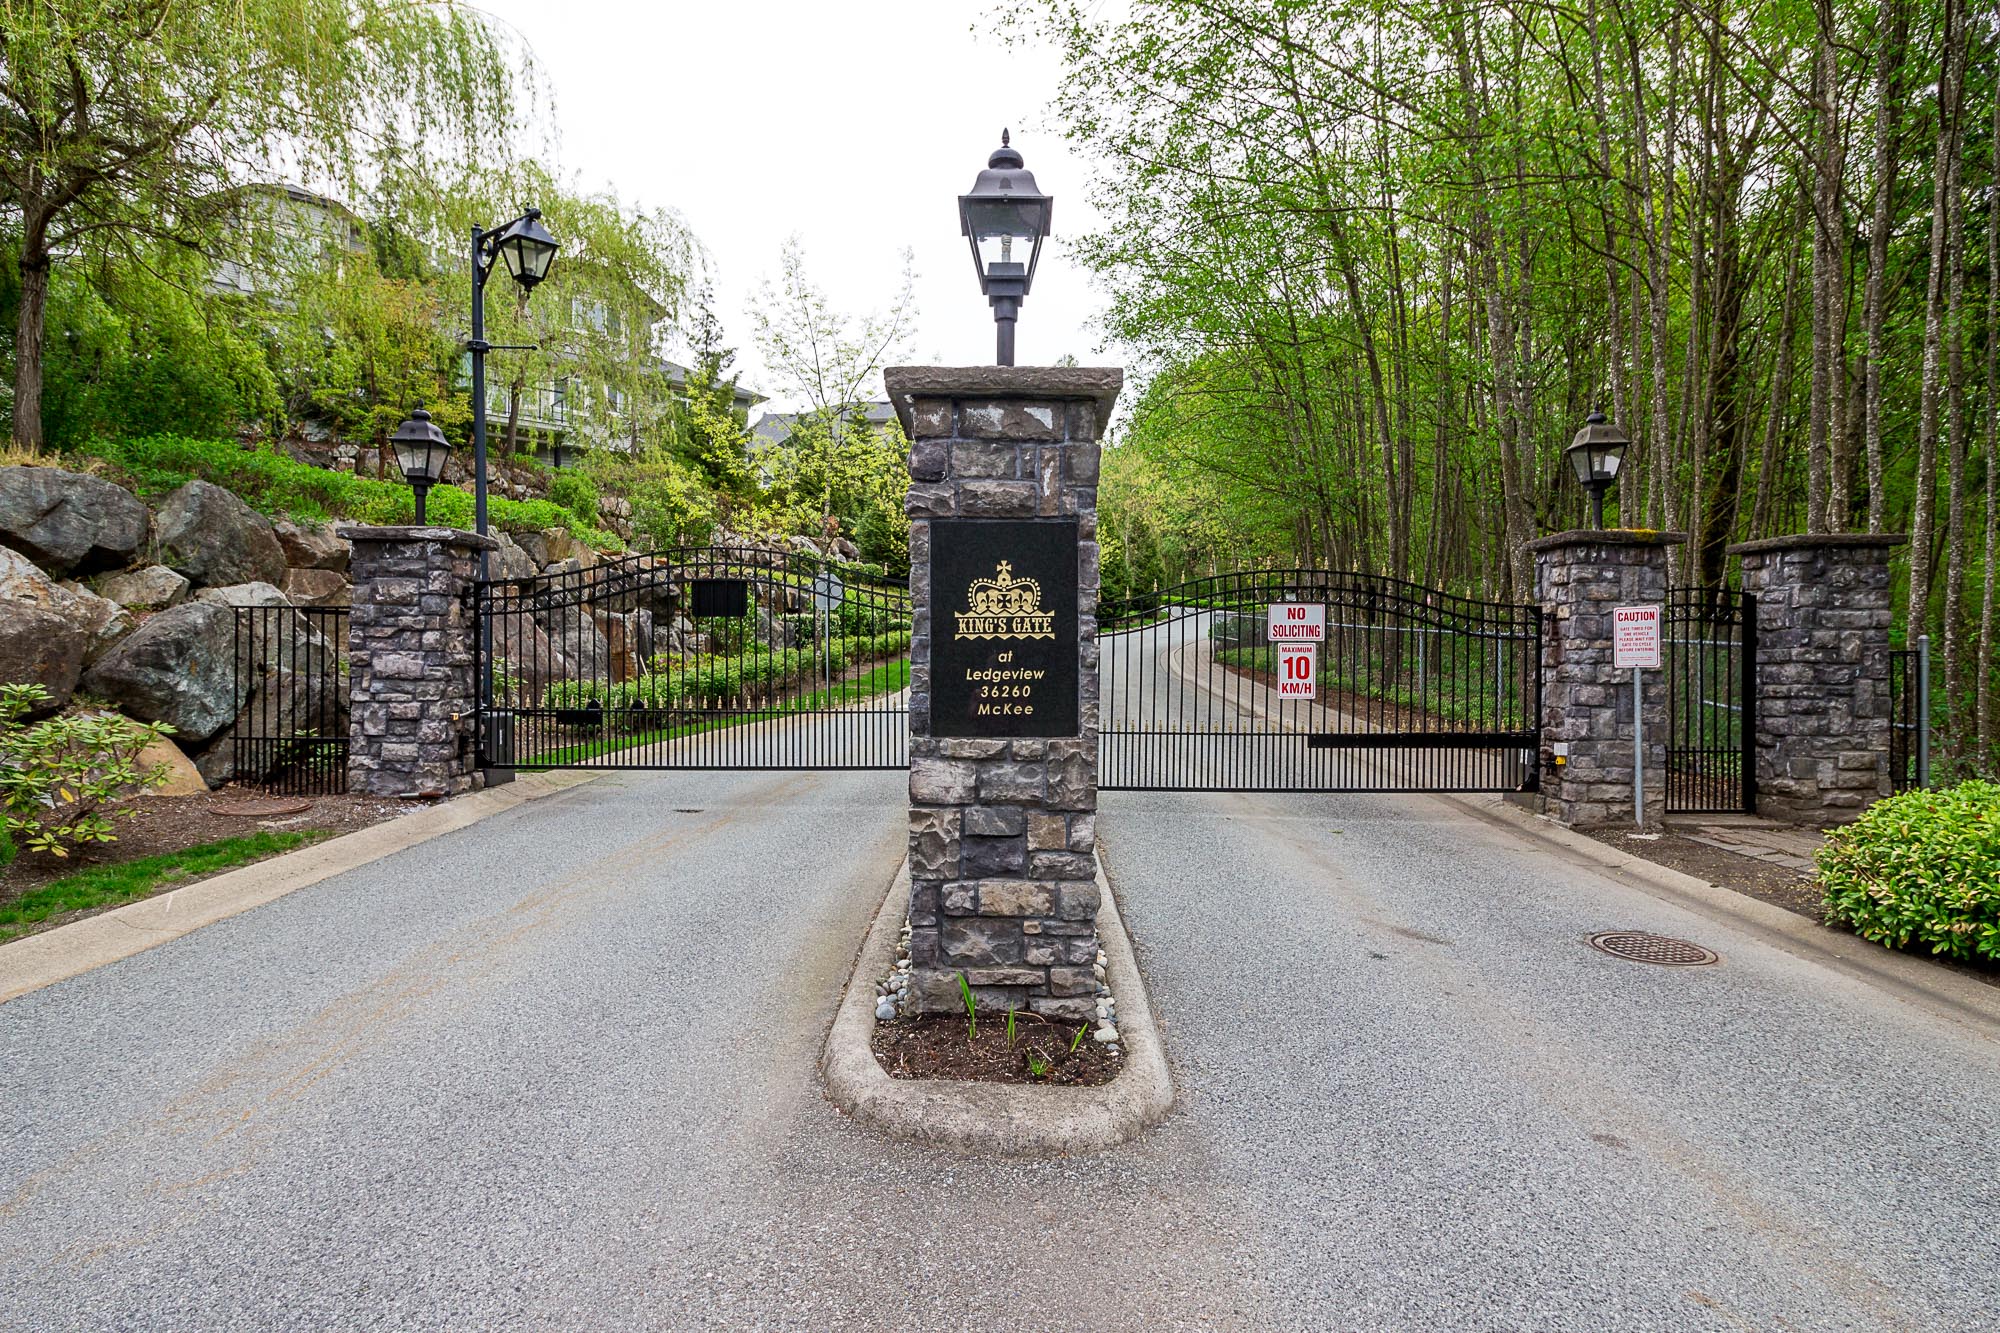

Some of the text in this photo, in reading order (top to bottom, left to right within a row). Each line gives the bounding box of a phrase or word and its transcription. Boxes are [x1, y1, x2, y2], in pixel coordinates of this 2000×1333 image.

[1287, 607, 1306, 620] NO
[1617, 611, 1655, 622] CAUTION
[958, 617, 1052, 633] KING'S GATE
[1272, 624, 1320, 638] SOLICITING
[998, 650, 1013, 662] at
[1283, 655, 1310, 681] 10
[966, 667, 1045, 683] Ledgeview
[980, 685, 1031, 698] 36260
[1281, 682, 1312, 694] KM/H
[977, 703, 1034, 715] McKee
